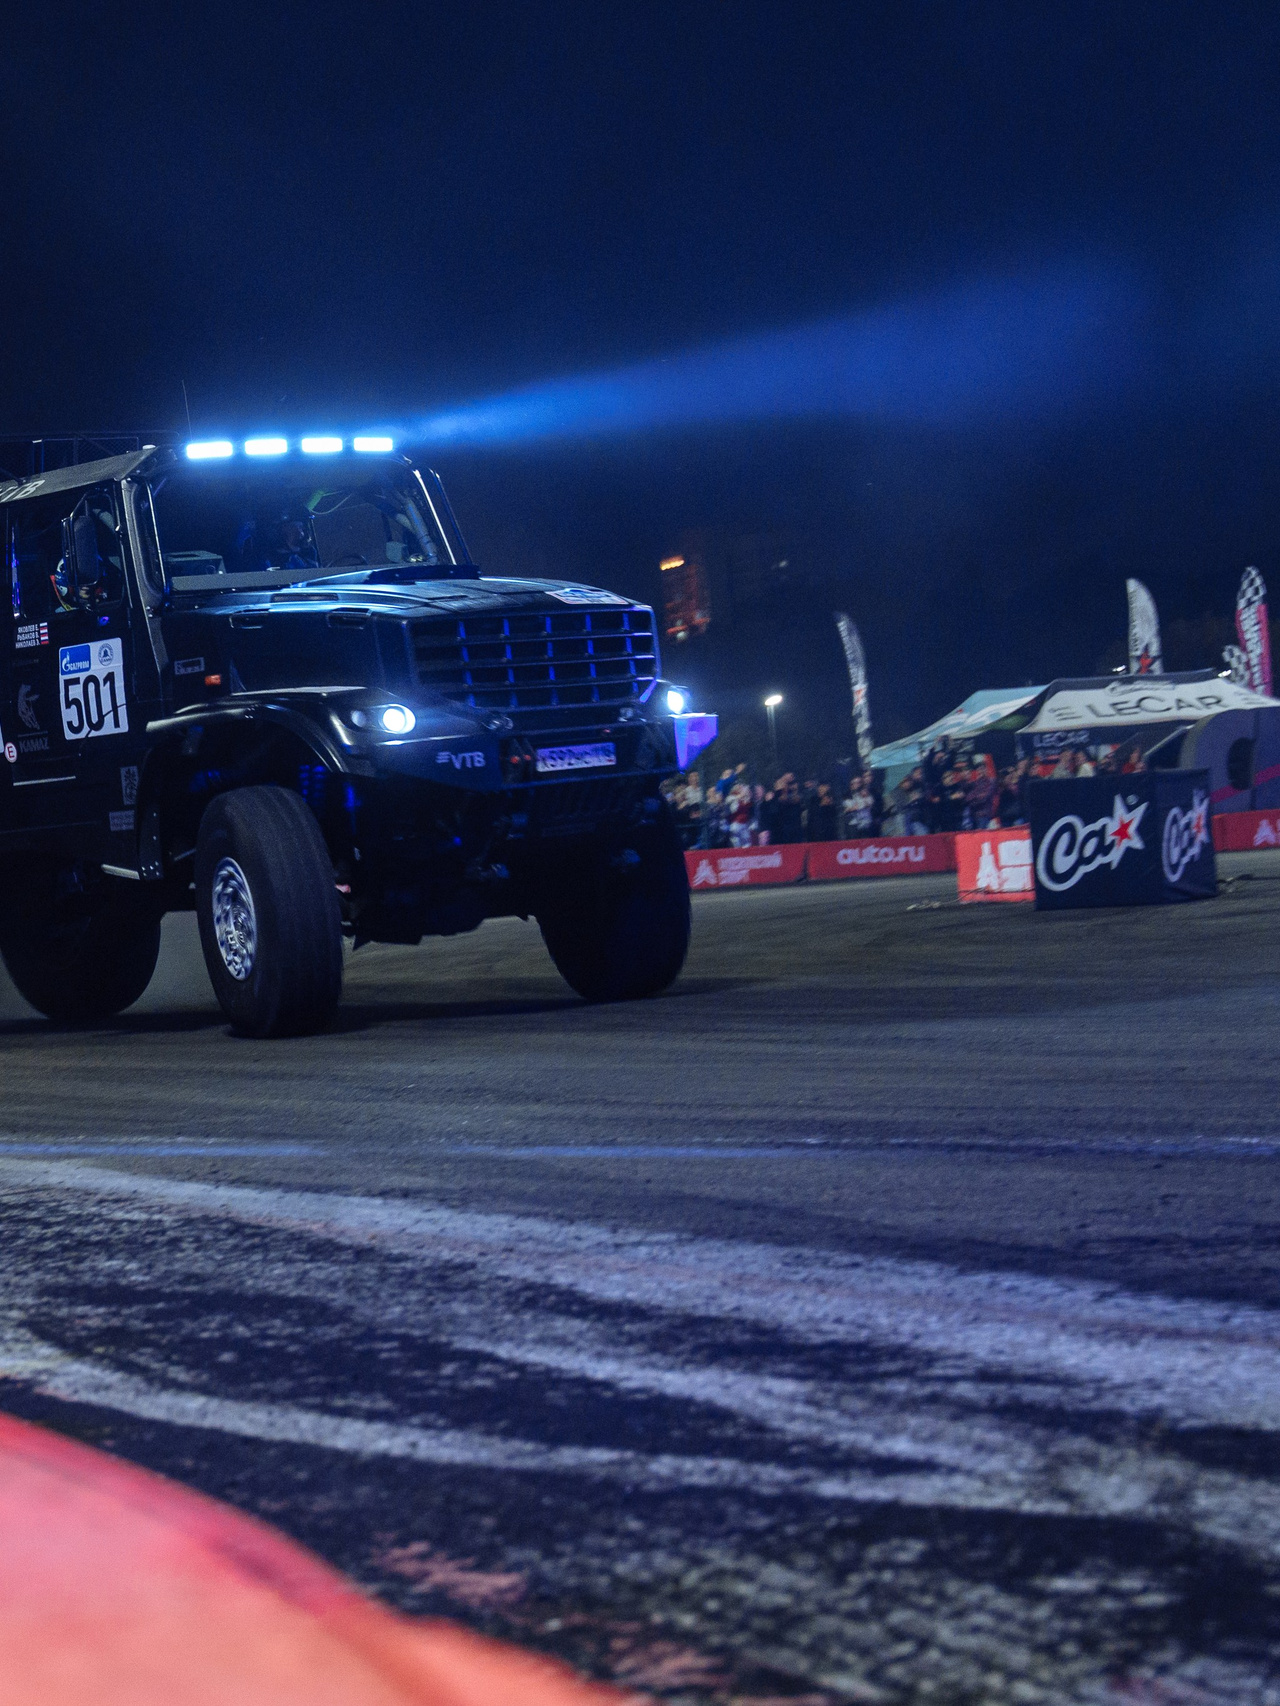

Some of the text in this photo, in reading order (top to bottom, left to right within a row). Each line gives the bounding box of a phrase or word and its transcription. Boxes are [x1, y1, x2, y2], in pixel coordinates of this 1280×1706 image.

[63, 671, 120, 735] 501
[1086, 694, 1226, 718] LECAR
[19, 737, 49, 753] KAMAZ
[1032, 730, 1090, 748] LECAR
[7, 745, 15, 758] E
[450, 751, 486, 770] VTB
[837, 846, 925, 864] auto.ru
